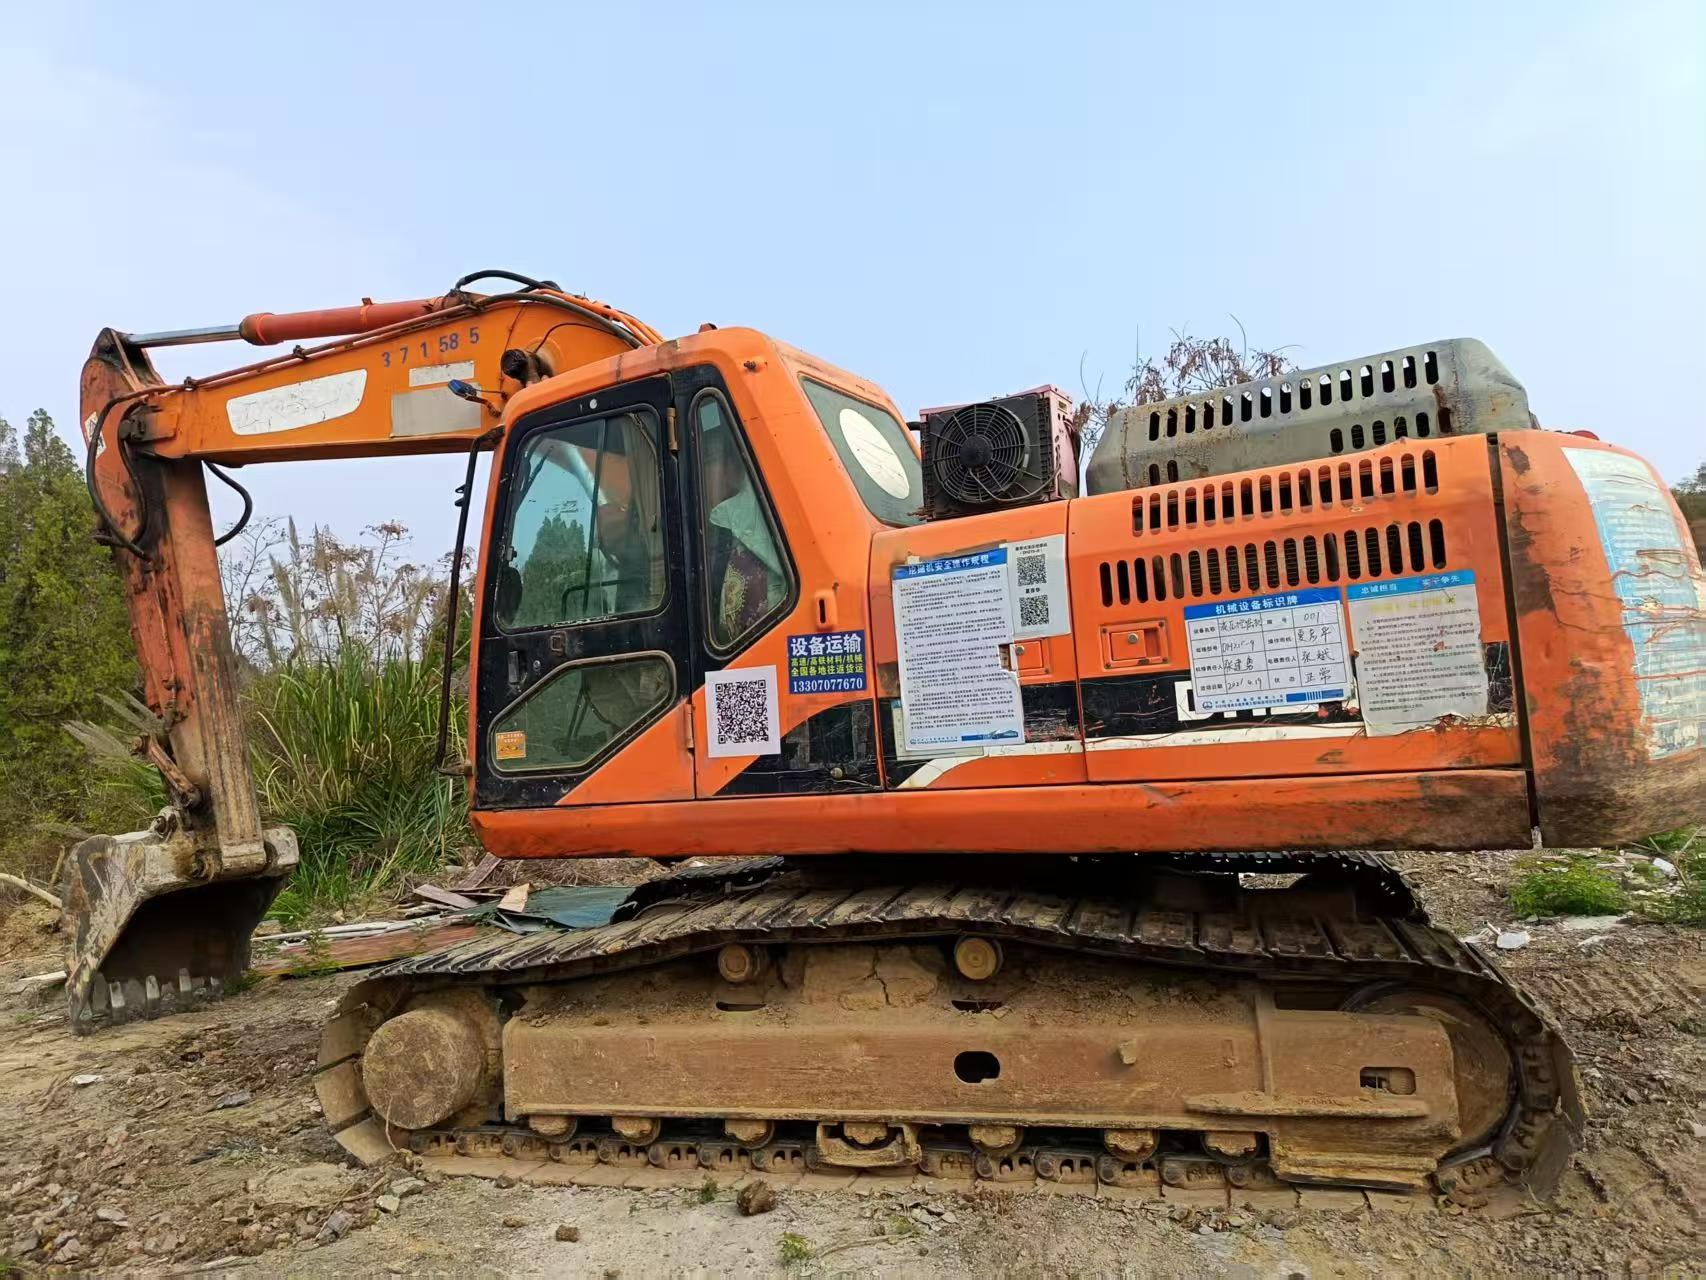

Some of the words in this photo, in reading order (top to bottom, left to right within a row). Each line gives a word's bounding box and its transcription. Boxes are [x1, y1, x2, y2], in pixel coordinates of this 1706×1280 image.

[1215, 595, 1298, 615] 机械设备标识牌
[1303, 611, 1320, 623] 001
[790, 633, 862, 657] 设备运输
[791, 663, 864, 677] 全国各地往返货运
[793, 677, 863, 693] 13307077670
